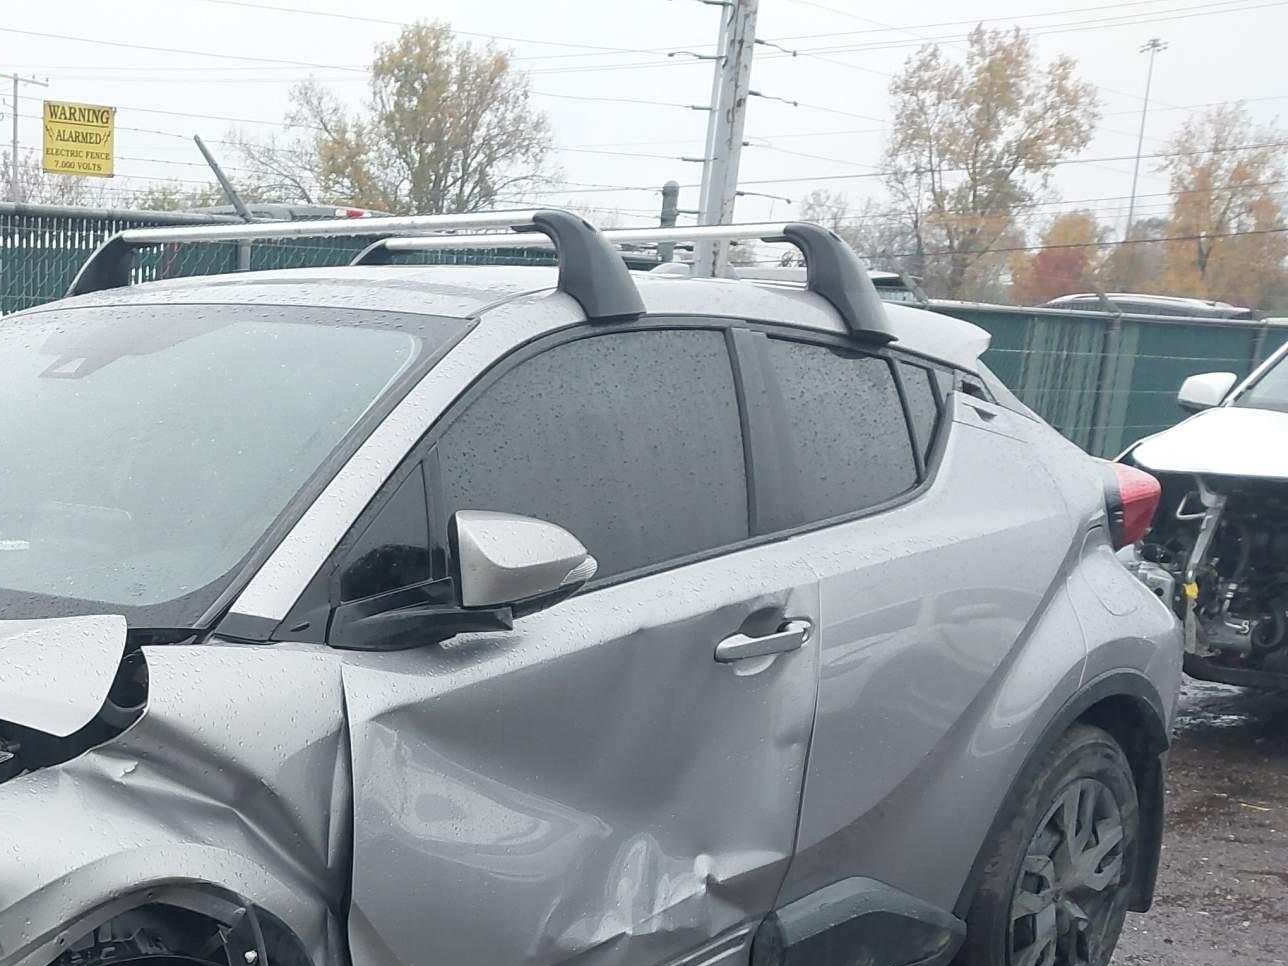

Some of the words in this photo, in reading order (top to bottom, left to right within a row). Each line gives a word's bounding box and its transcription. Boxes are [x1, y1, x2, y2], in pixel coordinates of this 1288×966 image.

[48, 104, 110, 125] WARNING
[55, 129, 101, 145] ALARMED
[46, 148, 83, 158] ELECTRIC
[86, 151, 110, 160] FENCE
[77, 162, 102, 171] VOLTS
